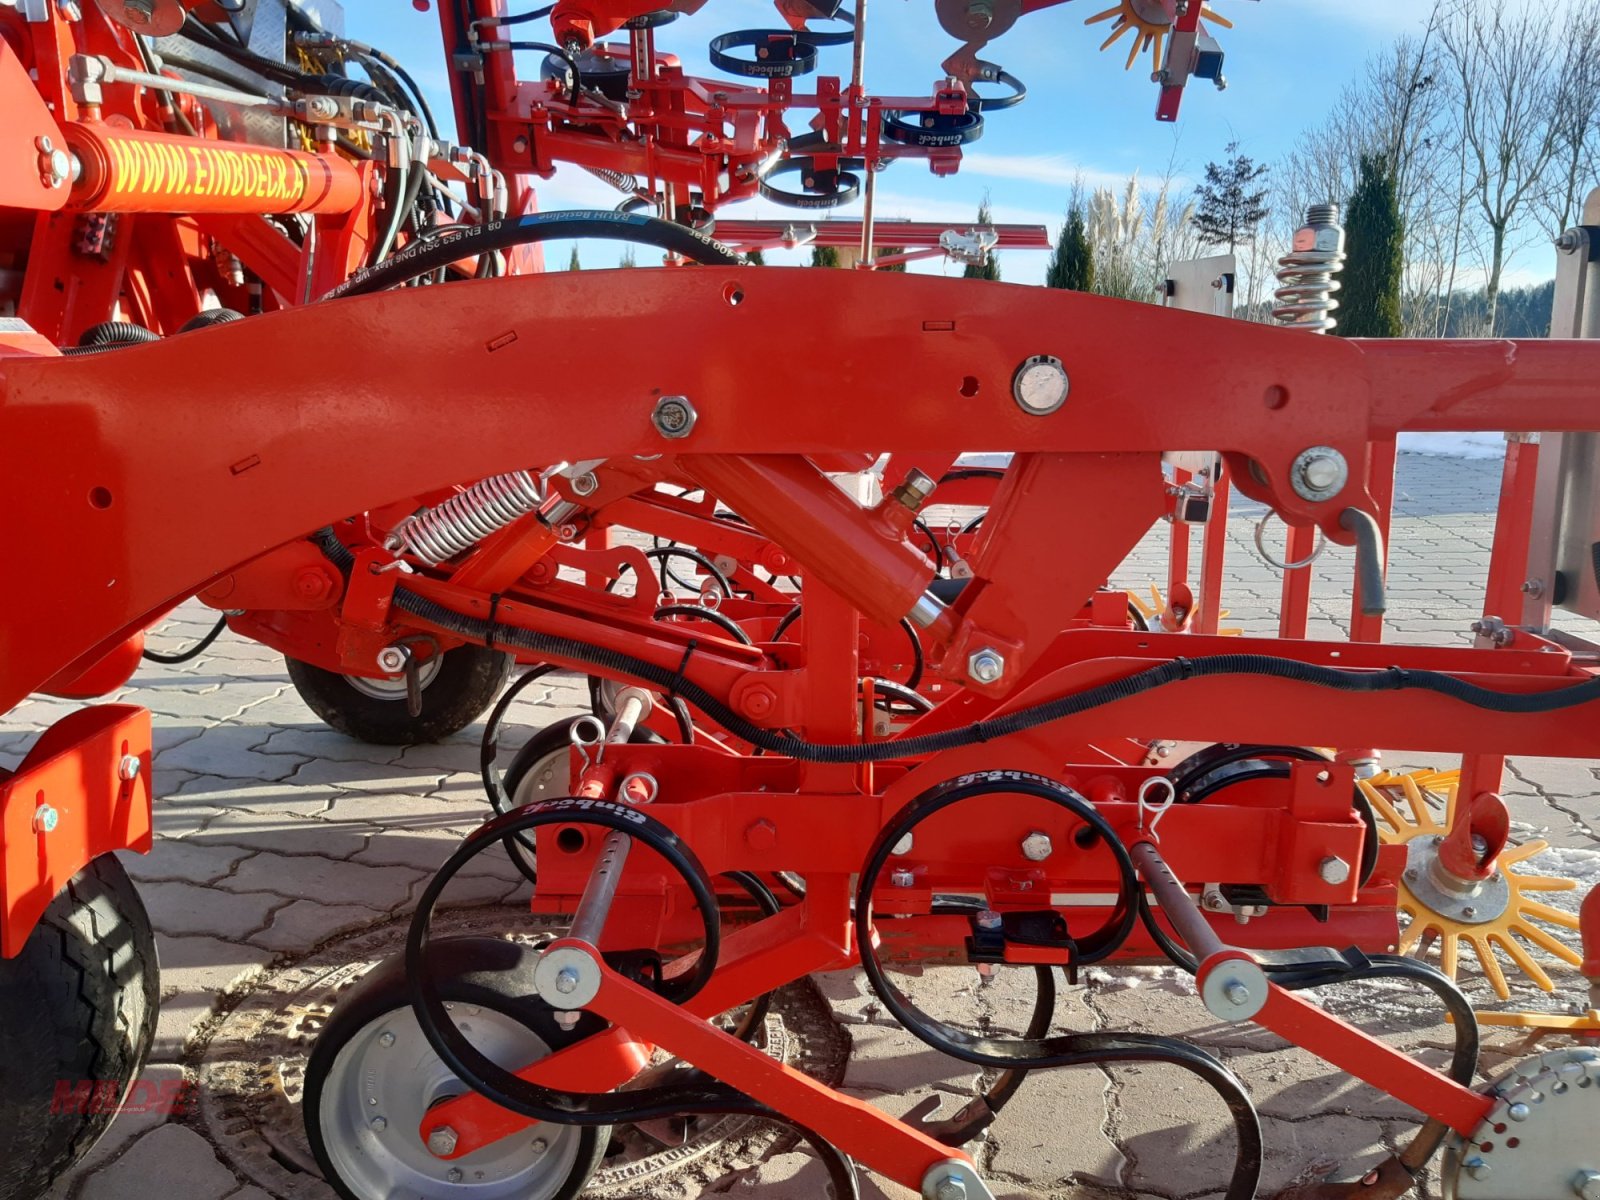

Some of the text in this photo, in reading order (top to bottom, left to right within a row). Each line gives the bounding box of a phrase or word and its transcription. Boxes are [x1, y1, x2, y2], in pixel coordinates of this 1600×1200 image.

[918, 134, 963, 146] Einböck
[107, 137, 310, 200] WWW.EINBOECK.AT
[538, 211, 590, 221] Basicline
[443, 233, 463, 246] 853
[464, 226, 482, 239] EN
[419, 240, 441, 256] 2SN
[688, 229, 733, 258] 400 Bar
[521, 798, 648, 826] Einböck
